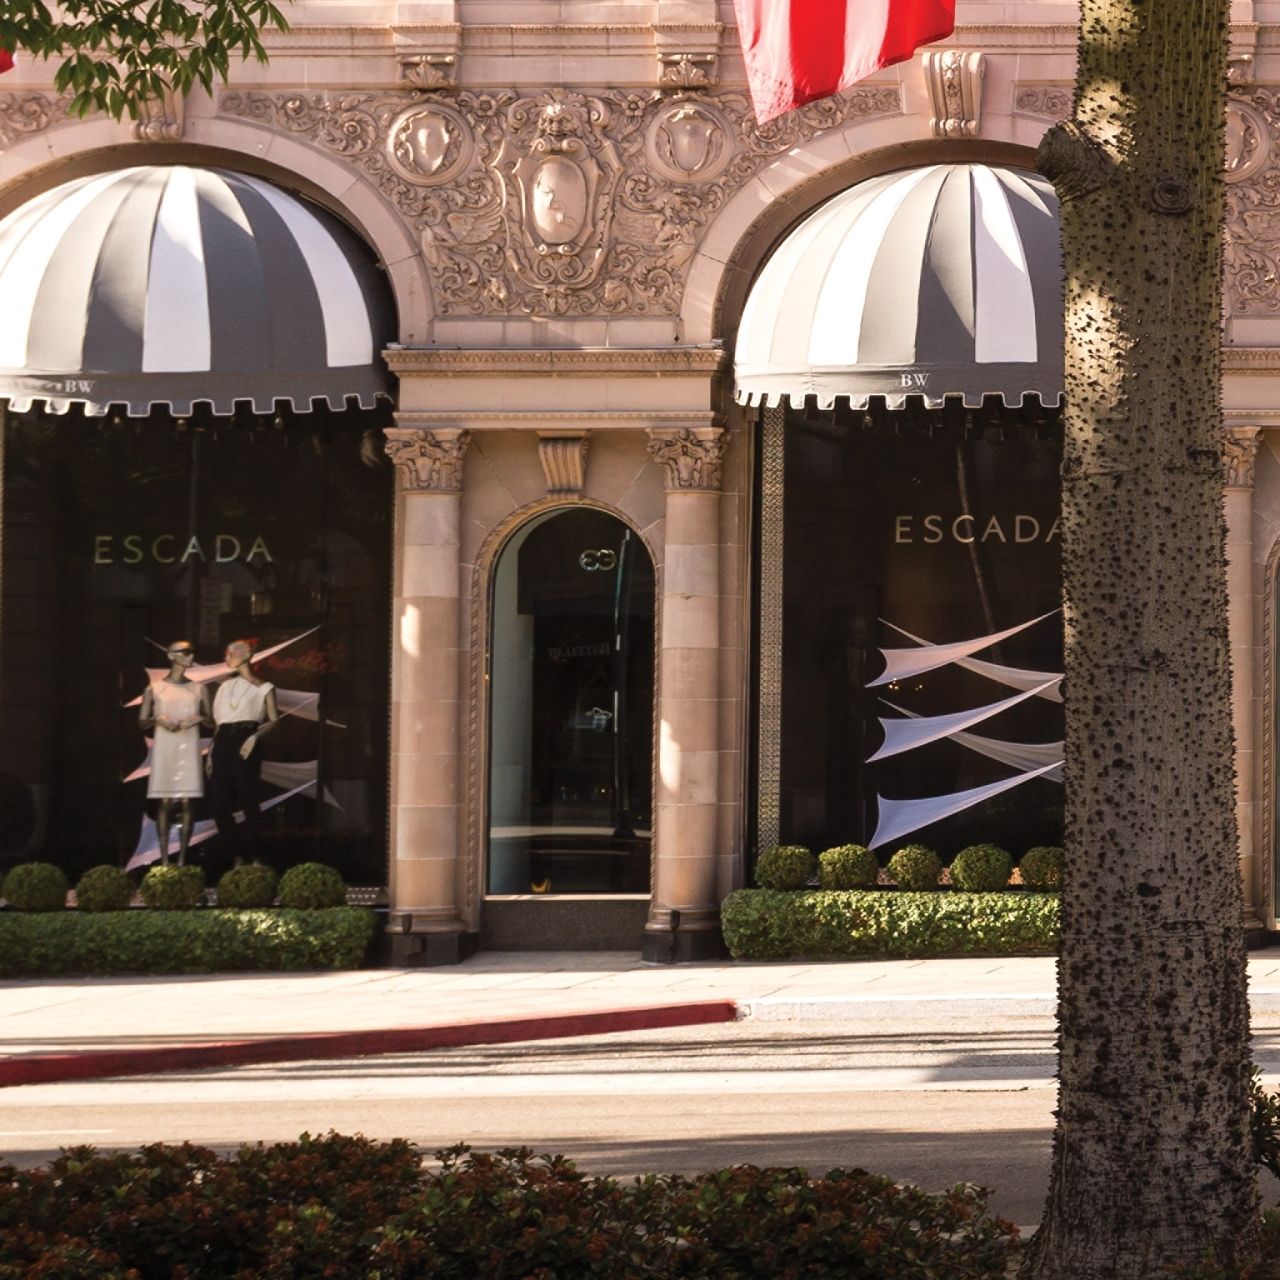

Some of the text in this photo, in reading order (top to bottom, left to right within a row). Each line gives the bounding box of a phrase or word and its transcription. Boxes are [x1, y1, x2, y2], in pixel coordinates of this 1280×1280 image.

[65, 380, 94, 393] BW
[901, 373, 930, 388] BW
[94, 535, 272, 564] ESCADA
